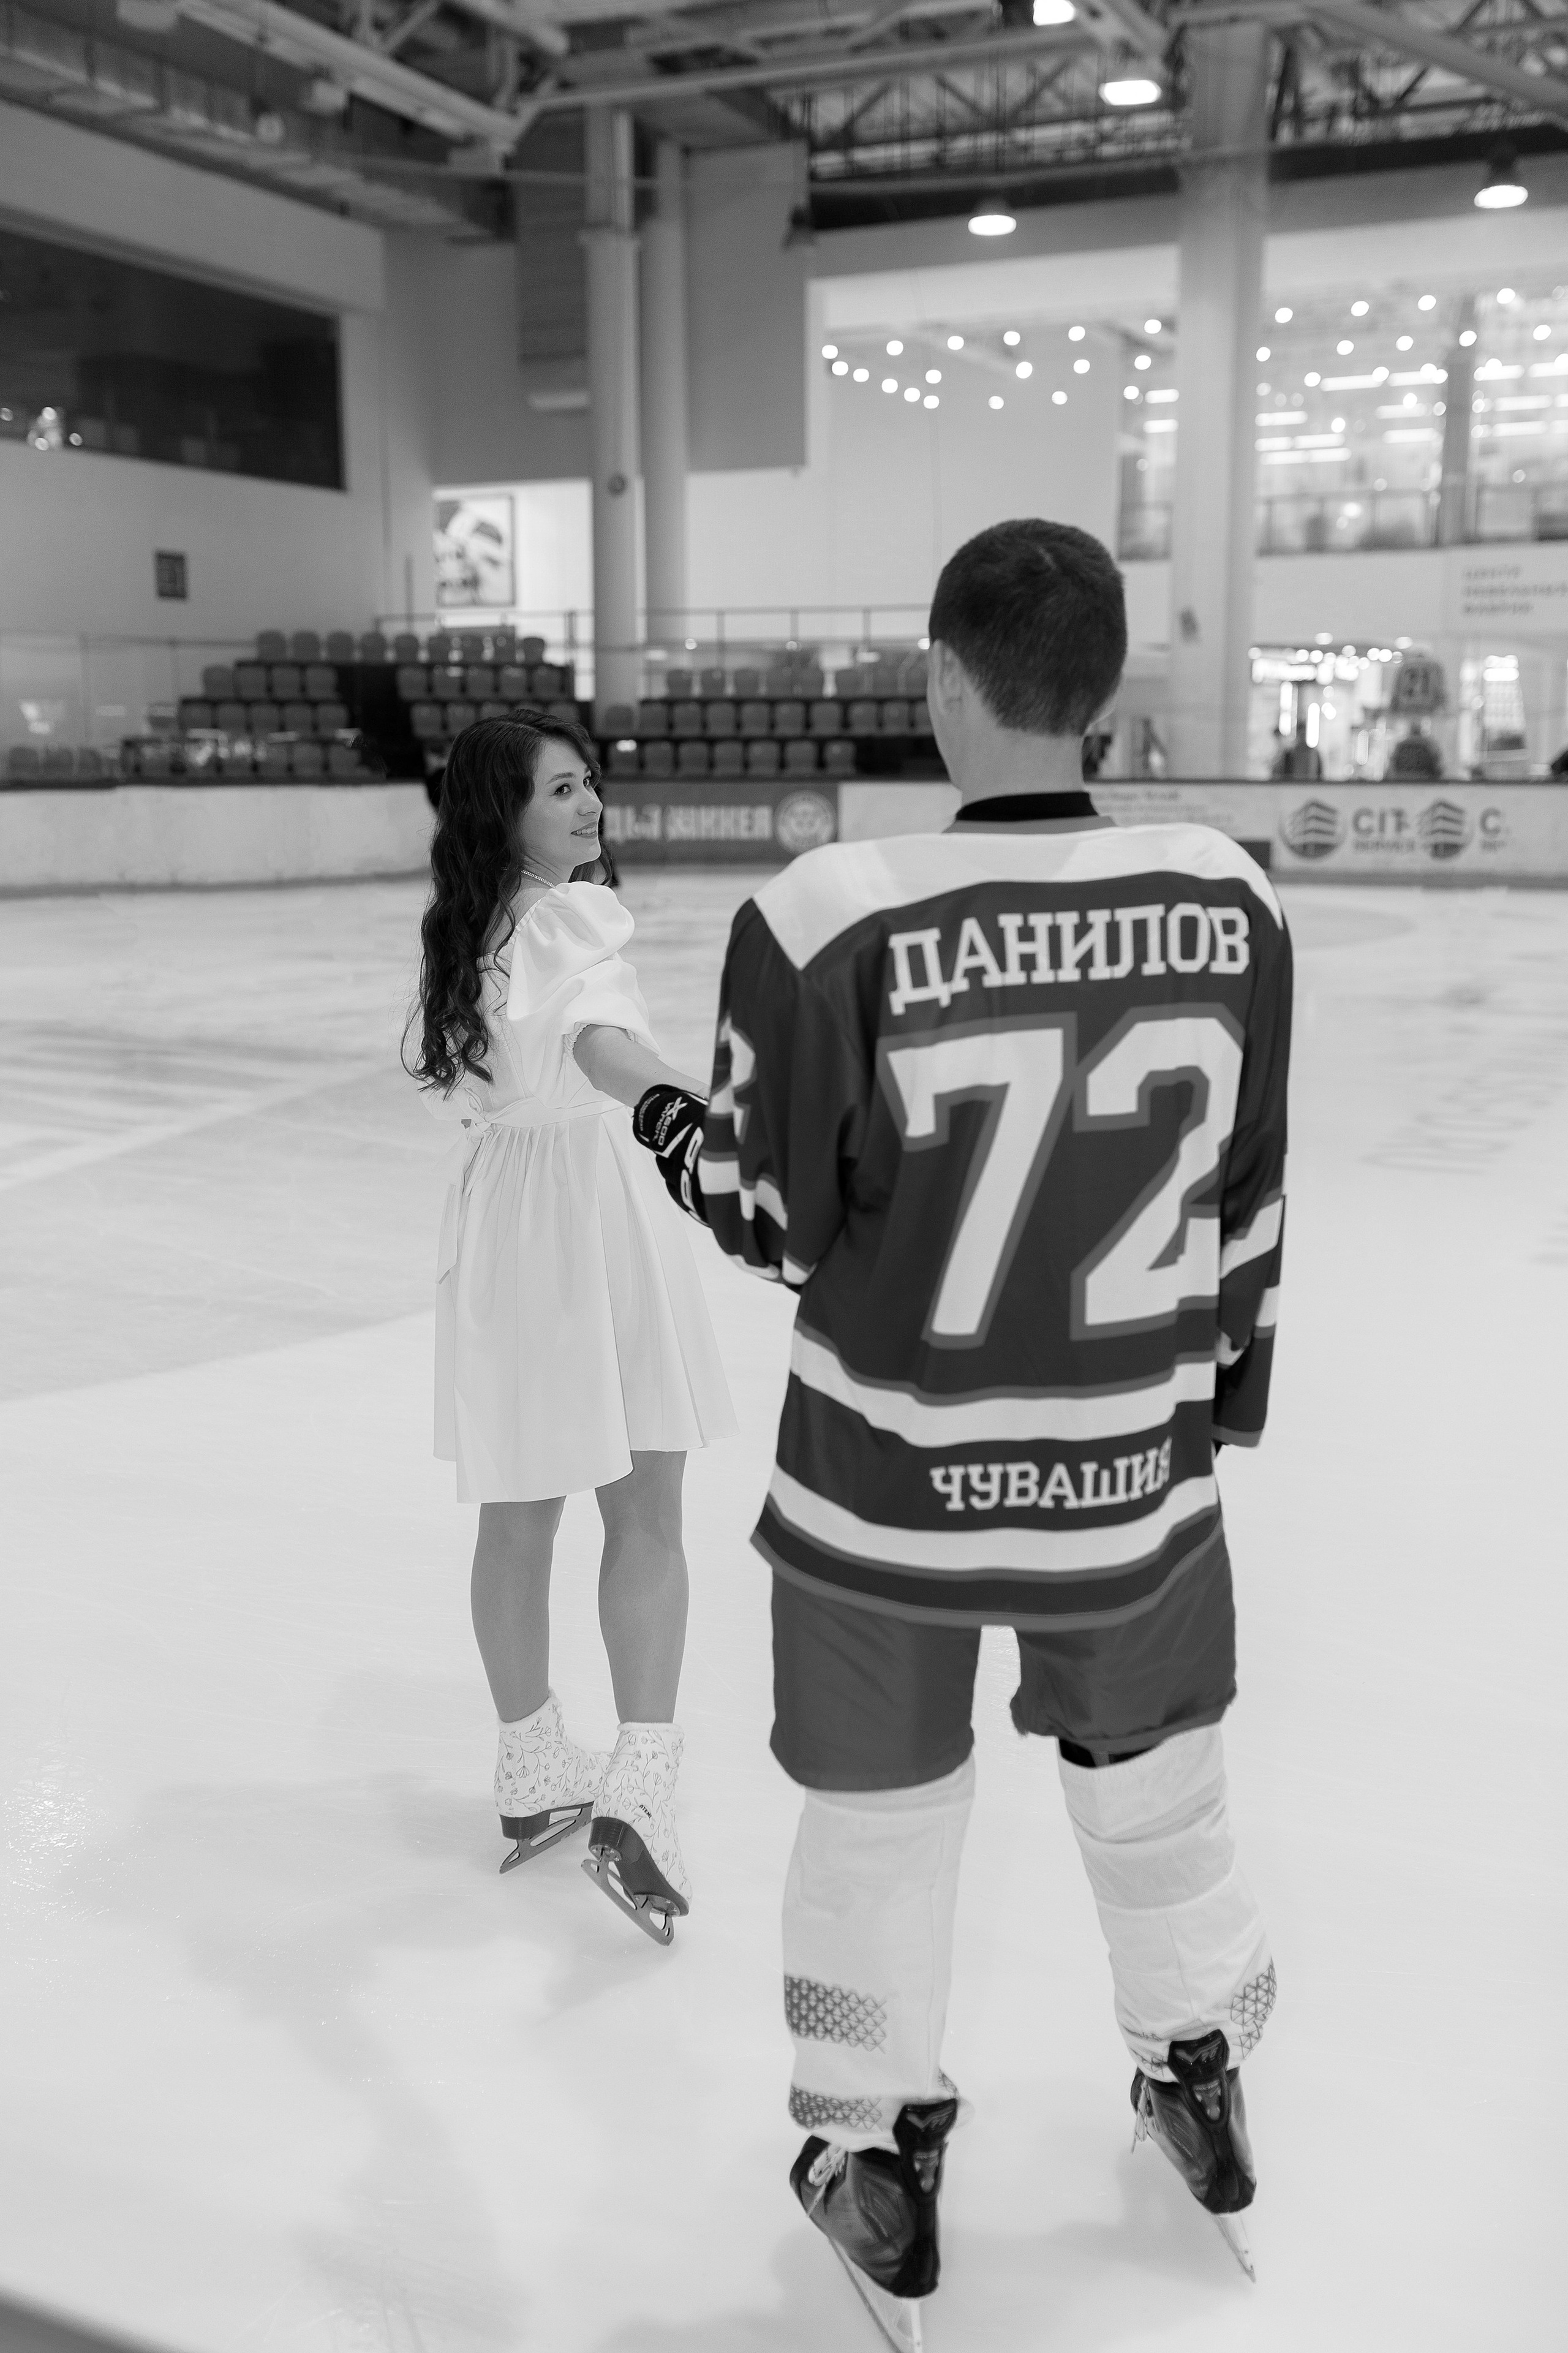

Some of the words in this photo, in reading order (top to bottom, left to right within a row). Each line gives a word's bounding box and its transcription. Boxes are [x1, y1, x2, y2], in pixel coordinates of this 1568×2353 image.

[888, 902, 1250, 1016] ДАНИЛОВ
[877, 1003, 1246, 1349] 72
[929, 1435, 1172, 1512] ЧУВАШИЯ
